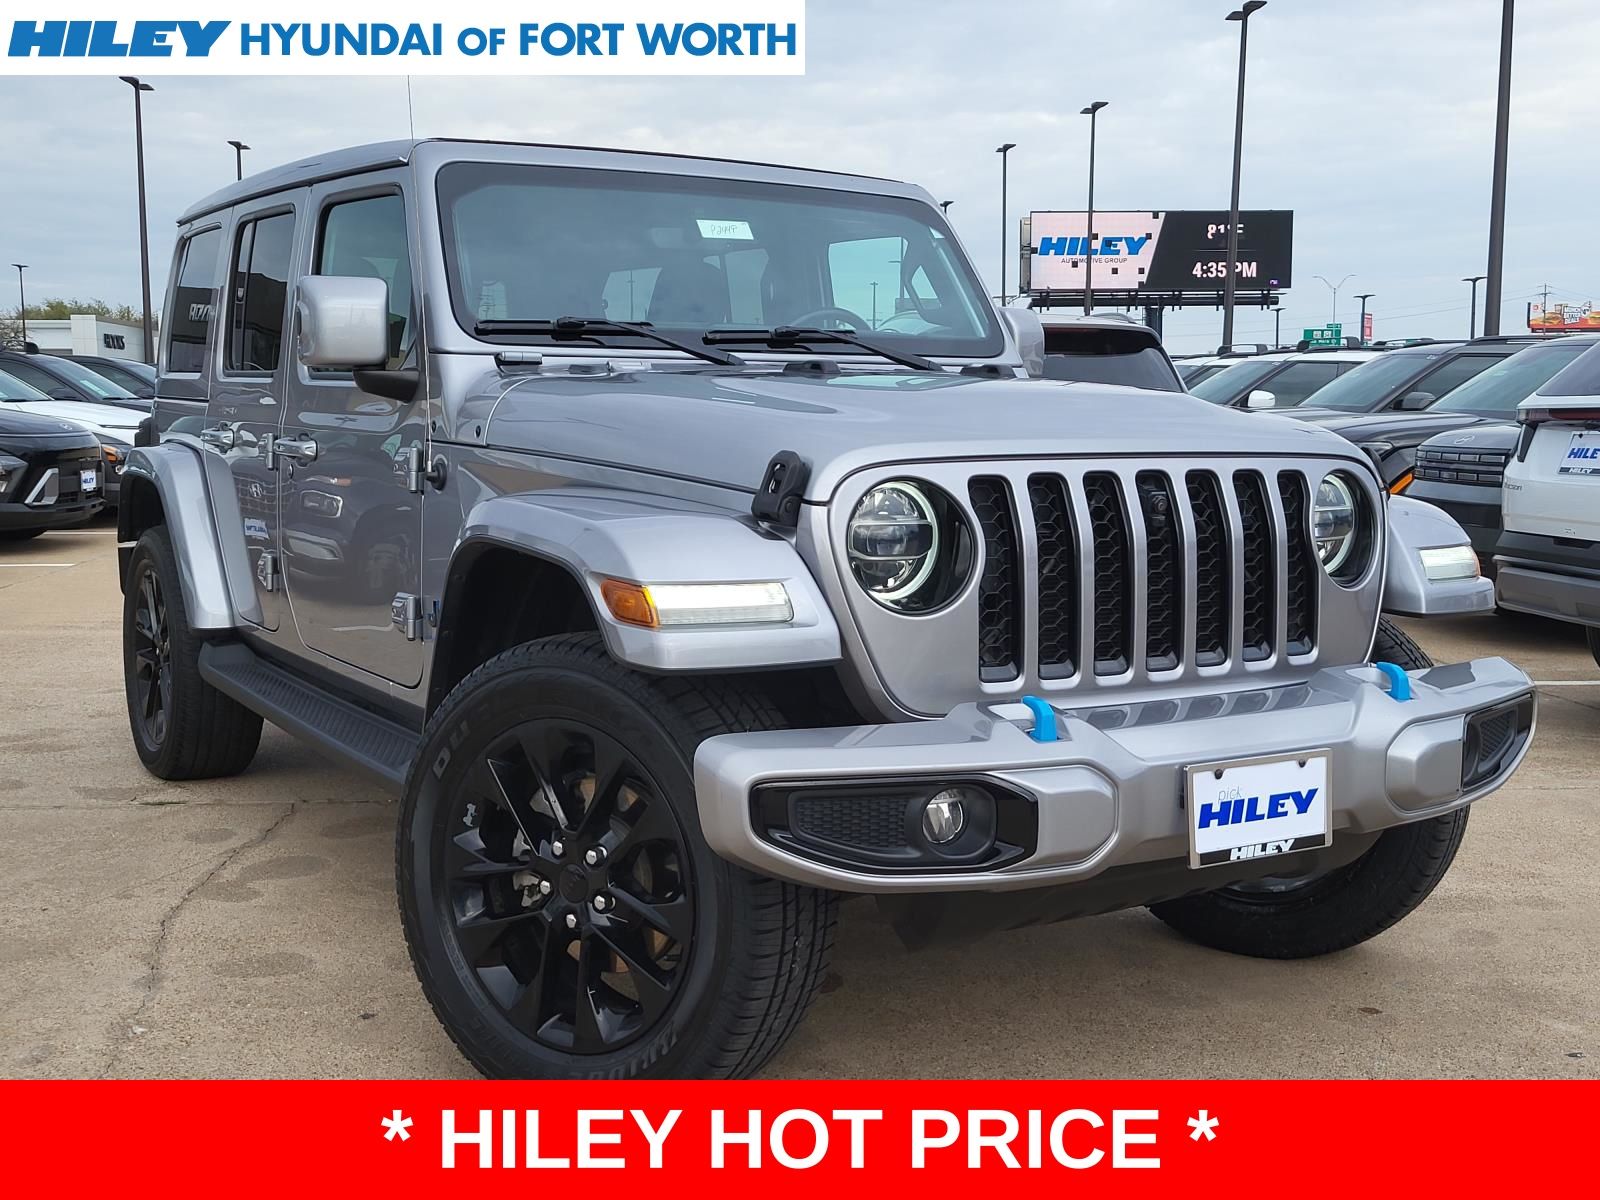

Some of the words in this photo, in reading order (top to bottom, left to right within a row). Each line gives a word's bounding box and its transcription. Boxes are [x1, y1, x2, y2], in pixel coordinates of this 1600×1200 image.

[1039, 237, 1147, 256] HILEY
[1192, 262, 1227, 278] 4:35
[1217, 786, 1243, 805] pick
[1198, 788, 1319, 829] HILEY
[1229, 839, 1295, 861] HILEY
